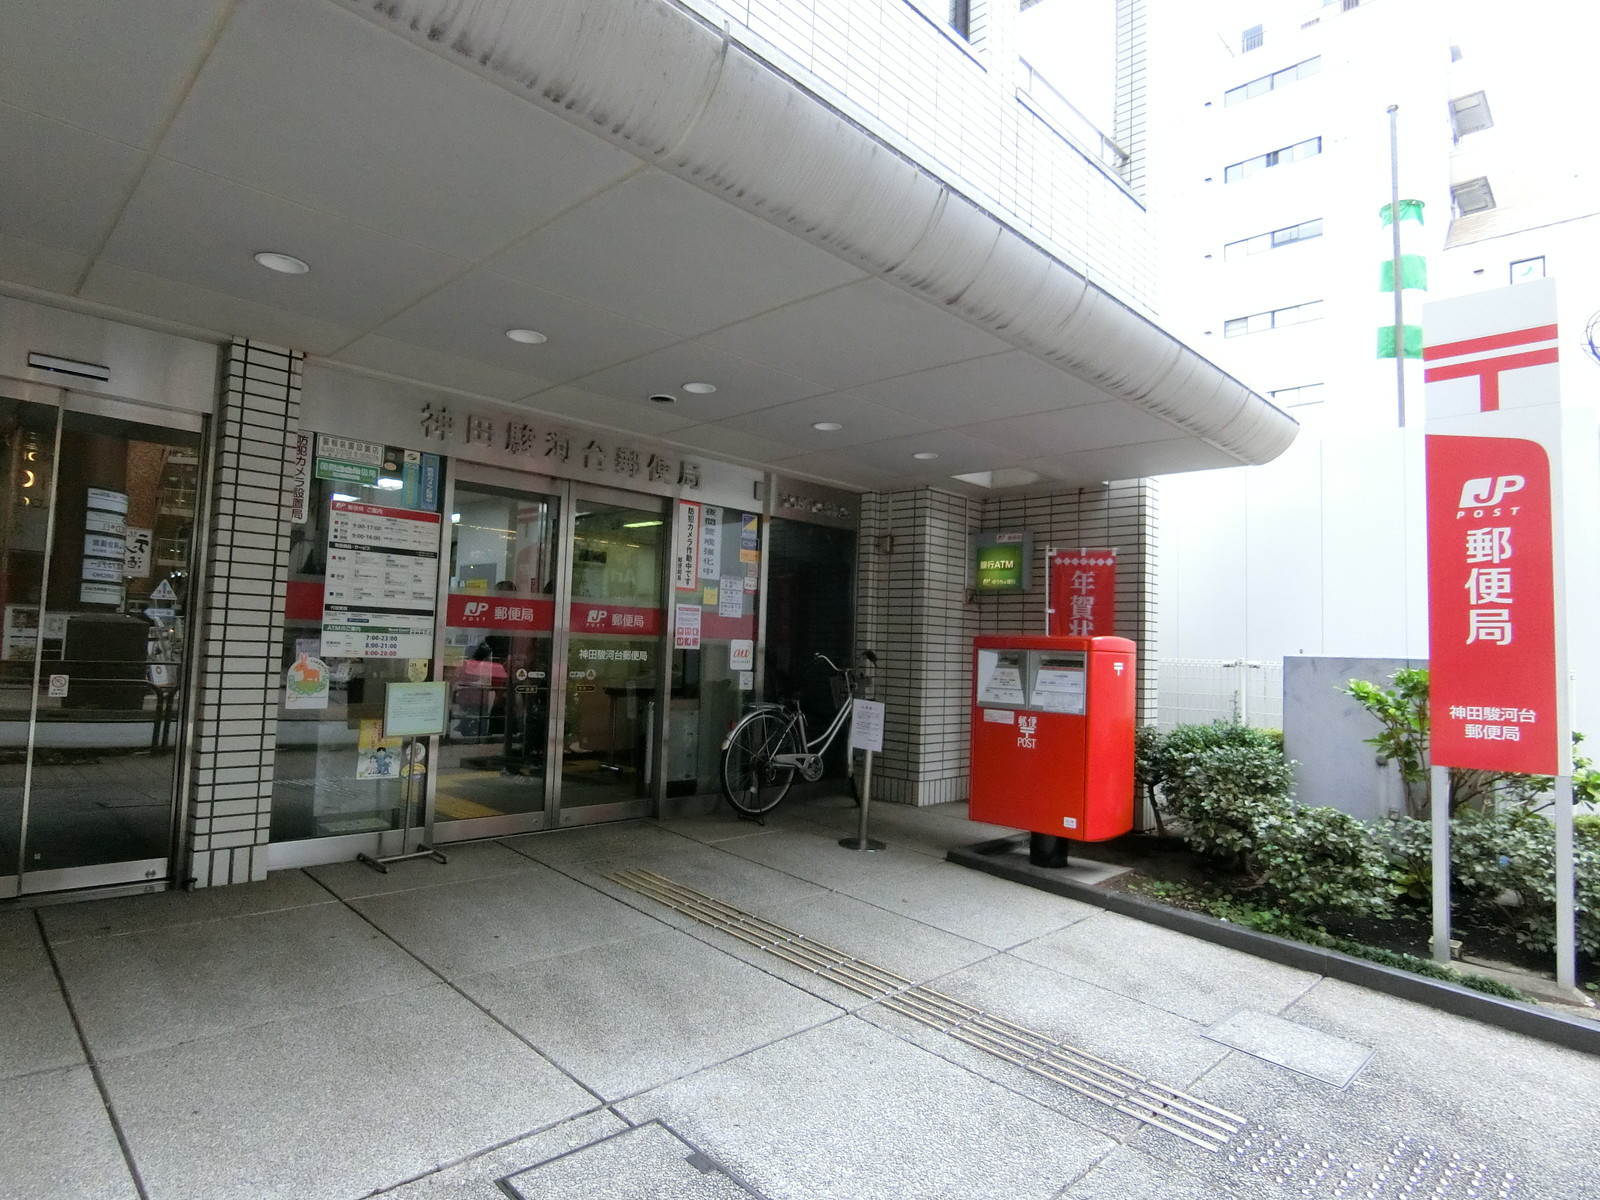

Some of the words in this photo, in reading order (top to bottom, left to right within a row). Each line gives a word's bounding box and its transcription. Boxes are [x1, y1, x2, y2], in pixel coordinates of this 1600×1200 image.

[420, 402, 700, 490] 神田駿河台郵便局
[292, 434, 309, 520] 防犯カメラ設置局
[1456, 507, 1521, 519] POST
[685, 507, 695, 586] 防犯カメラ作動中です
[703, 507, 716, 576] 夜間警戒強化中
[980, 560, 1014, 570] 銀行ATM
[1464, 526, 1514, 645] 郵便局
[494, 606, 534, 622] 郵便局
[611, 613, 645, 628] 郵便局
[579, 648, 648, 662] 神田駿河台郵便局
[733, 649, 751, 658] au
[1449, 704, 1537, 723] 神田駿河台
[1018, 716, 1037, 729] 郵便
[1464, 723, 1521, 741] 郵便局
[1017, 737, 1037, 749] POST
